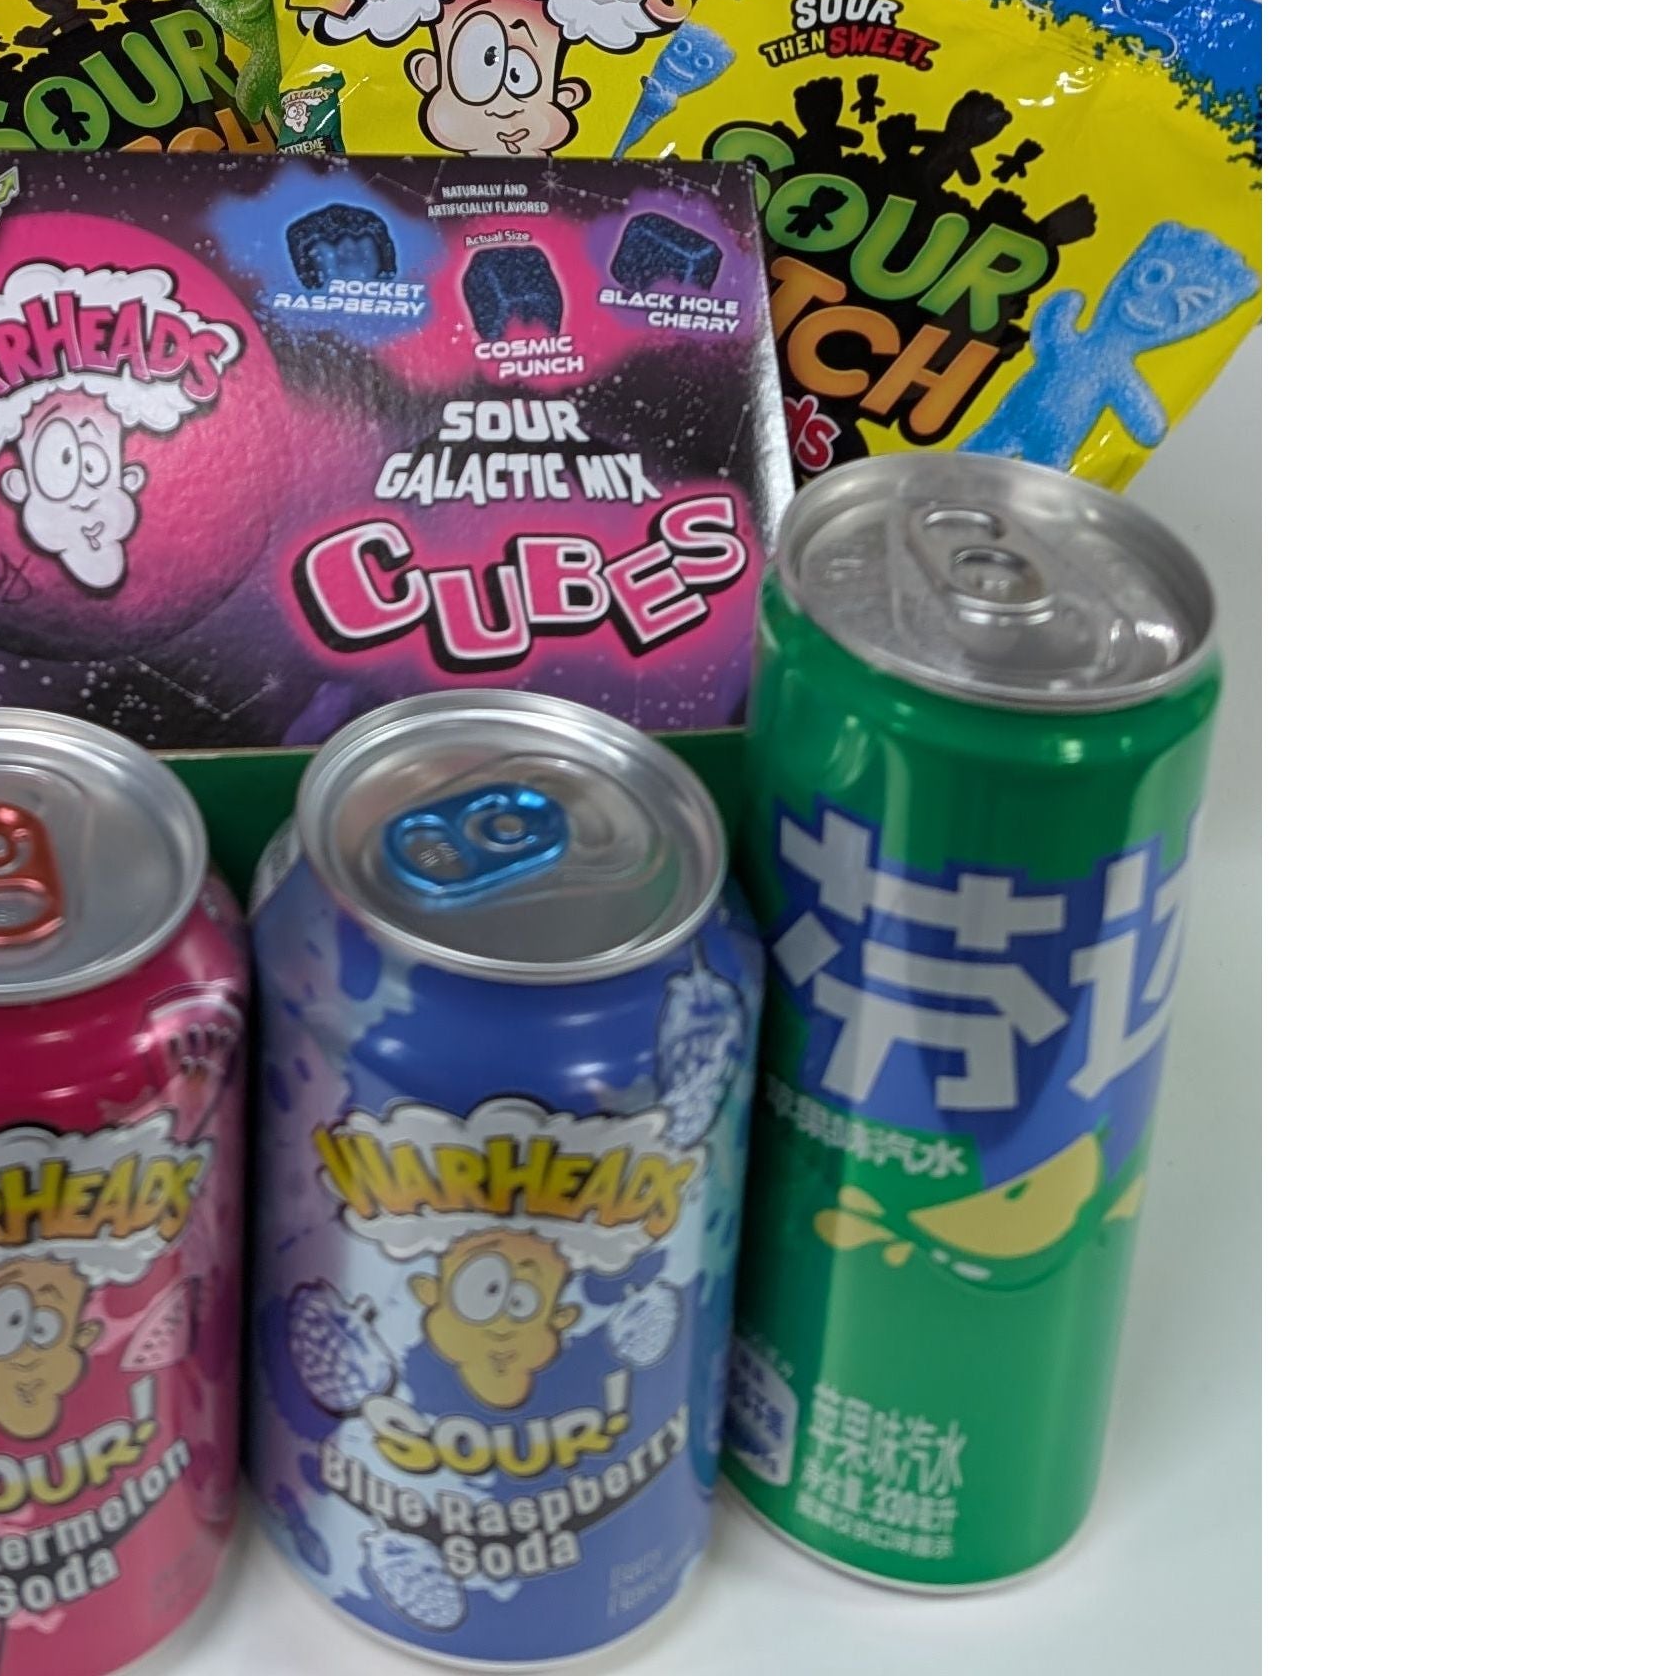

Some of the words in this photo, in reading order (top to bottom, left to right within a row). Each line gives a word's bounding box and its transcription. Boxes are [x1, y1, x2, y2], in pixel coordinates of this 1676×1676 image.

[764, 31, 826, 66] THEN
[441, 184, 502, 199] NATURALLY
[504, 183, 528, 197] AND
[427, 202, 494, 218] ARTIFICIALLY
[495, 200, 549, 215] FLAVORED
[464, 230, 502, 247] Actual
[504, 230, 530, 242] Size
[711, 126, 1050, 334] SOUR
[273, 293, 427, 318] RASPBERRY
[328, 280, 425, 299] ROCKET
[598, 289, 674, 311] BLACK
[679, 295, 740, 316] HOLE
[647, 311, 741, 335] CHERRY
[473, 335, 574, 361] COSMIC
[769, 255, 1001, 437] TCH
[498, 356, 585, 379] PUNCH
[440, 400, 589, 444] SOUR
[374, 451, 571, 506] GALACTIC
[578, 450, 662, 502] MIX
[305, 496, 749, 661] CUBES
[314, 1128, 697, 1238] WARHEADS
[363, 1369, 631, 1477] SOUR!
[321, 1444, 429, 1526] Blue
[440, 1406, 690, 1537] Raspberry
[443, 1530, 581, 1580] Soda
